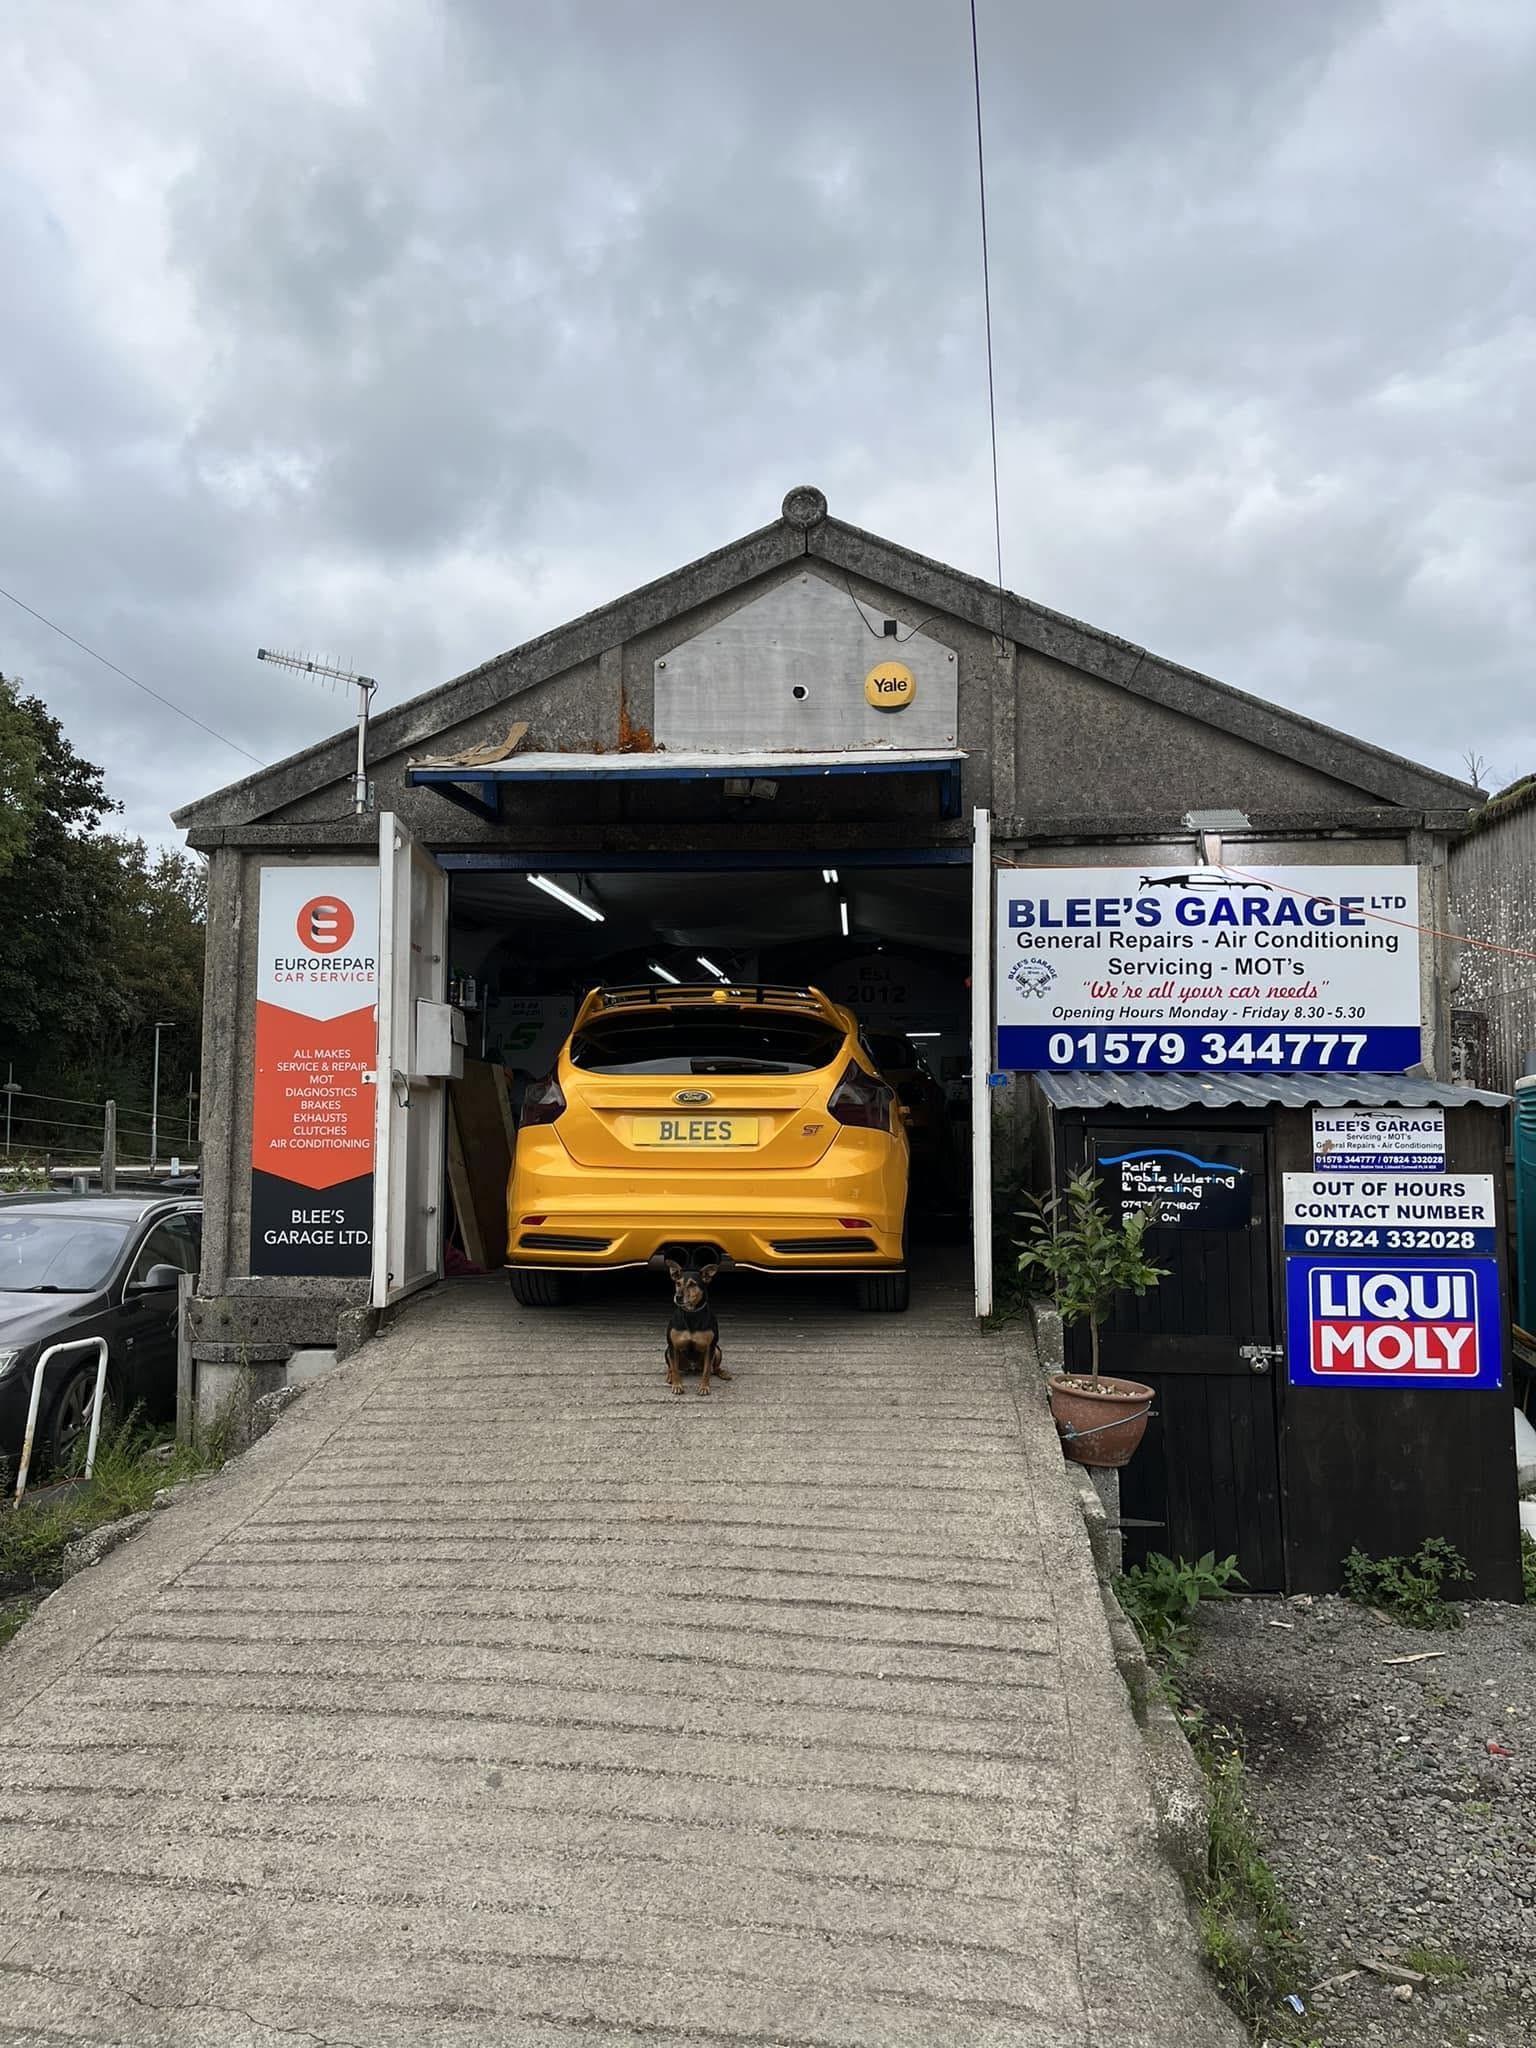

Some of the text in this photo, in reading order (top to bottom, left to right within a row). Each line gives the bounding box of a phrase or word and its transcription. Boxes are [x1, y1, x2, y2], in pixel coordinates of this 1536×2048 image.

[873, 677, 907, 692] Yale
[1008, 896, 1407, 929] BLEE'S GARAGE LTD
[1017, 931, 1101, 949] General
[1110, 931, 1194, 952] Repairs
[1215, 931, 1247, 948] Air
[1254, 931, 1399, 952] Conditioning
[274, 958, 375, 970] EUROREPAR
[1108, 958, 1212, 979] Servicing
[1235, 958, 1305, 975] MOT's
[274, 972, 375, 982] CAR SERVICE
[847, 985, 906, 1003] 2012
[1147, 981, 1175, 998] all
[1177, 984, 1223, 1003] your
[1228, 985, 1260, 998] car
[1052, 1006, 1115, 1021] Opening
[1119, 1006, 1164, 1018] Hours
[1168, 1006, 1228, 1021] Monday
[1242, 1006, 1290, 1021] Friday
[293, 1049, 351, 1058] ALL MAKES
[1048, 1032, 1368, 1065] 01579 344777
[277, 1062, 367, 1071] SERVICE & REPAIR
[310, 1075, 334, 1084] MOT
[285, 1088, 357, 1097] DIAGNOSTICS
[301, 1100, 341, 1110] BRAKES
[293, 1113, 347, 1122] EXHAUSTS
[293, 1126, 347, 1135] CLUTCHES
[659, 1120, 732, 1141] BLEES
[1315, 1121, 1443, 1132] BLEE'S GARAGE
[269, 1139, 370, 1149] AIR CONDITIONING
[1346, 1133, 1381, 1142] Servicing
[1346, 1141, 1375, 1150] Repairs
[1394, 1141, 1443, 1151] Conditioning
[1315, 1156, 1343, 1164] 01579
[1344, 1156, 1377, 1164] 344777
[1382, 1156, 1410, 1164] 07824
[1411, 1156, 1443, 1164] 332028
[1121, 1172, 1235, 1189] Mobile Valeting
[1122, 1183, 1203, 1198] & Detailing
[1312, 1182, 1466, 1197] OUT OF HOURS
[291, 1209, 345, 1224] BLEE'S
[1295, 1204, 1485, 1220] CONTACT NUMBER
[264, 1230, 372, 1245] GARAGE LTD.
[1305, 1230, 1475, 1249] 07824 332028
[1319, 1274, 1468, 1321] LIQUI
[1321, 1325, 1475, 1370] MOLY
